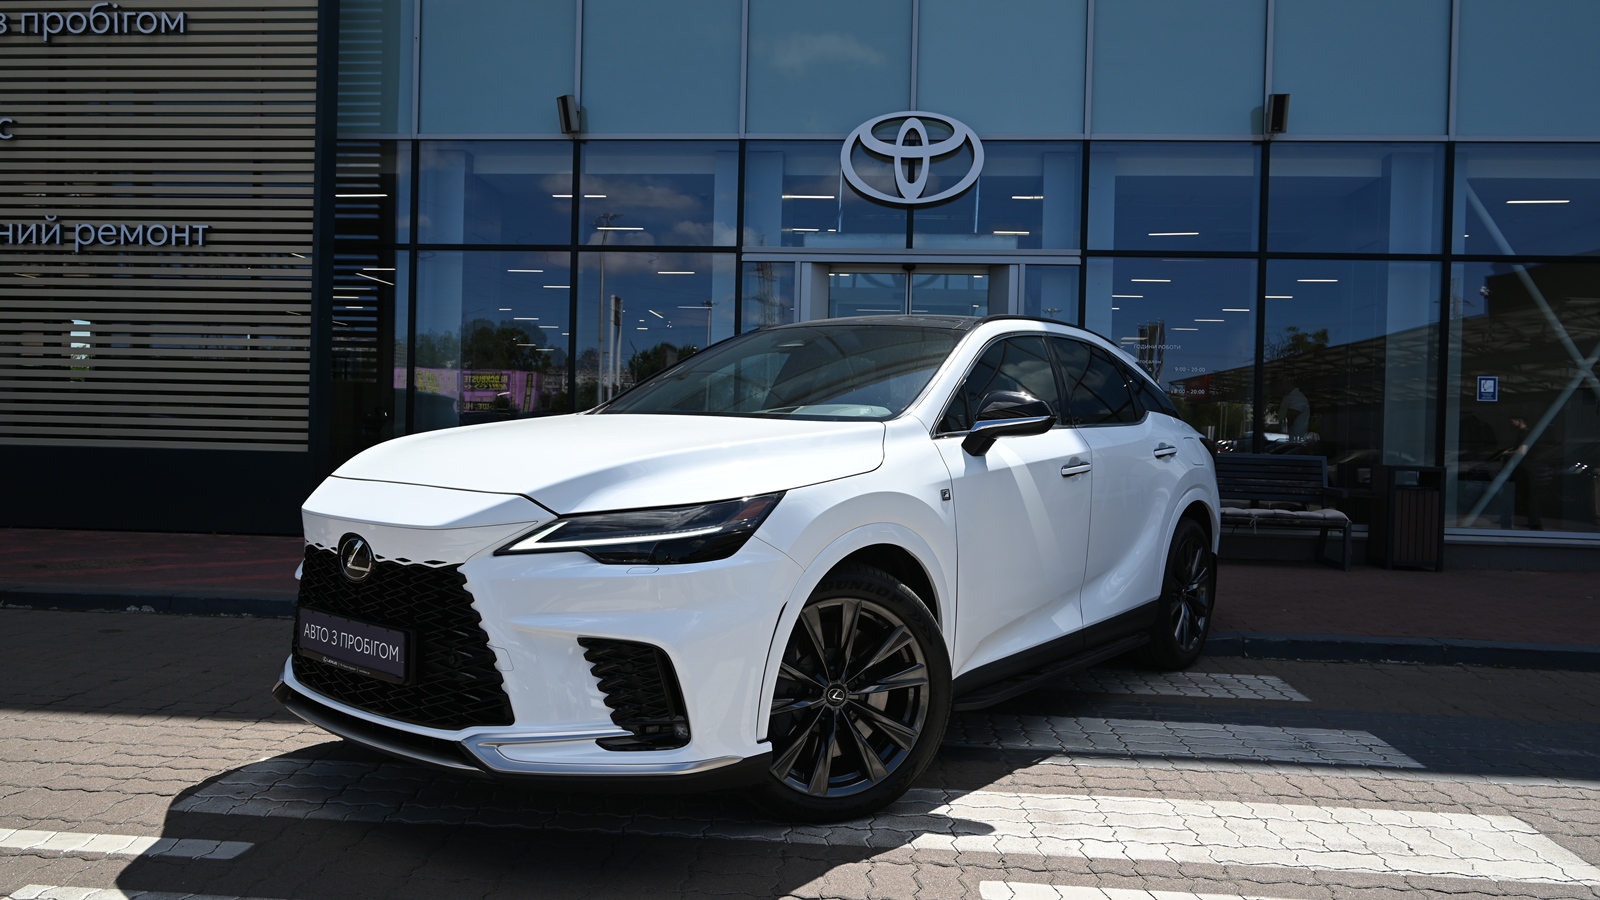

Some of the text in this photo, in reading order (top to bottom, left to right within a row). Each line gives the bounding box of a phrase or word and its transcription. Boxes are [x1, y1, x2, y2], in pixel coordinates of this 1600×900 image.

[20, 2, 186, 42] пробігом
[74, 222, 209, 252] ремонт
[819, 579, 904, 604] DUNLOP
[303, 623, 329, 643] АВТО
[340, 632, 399, 662] ПРОБІГОМ
